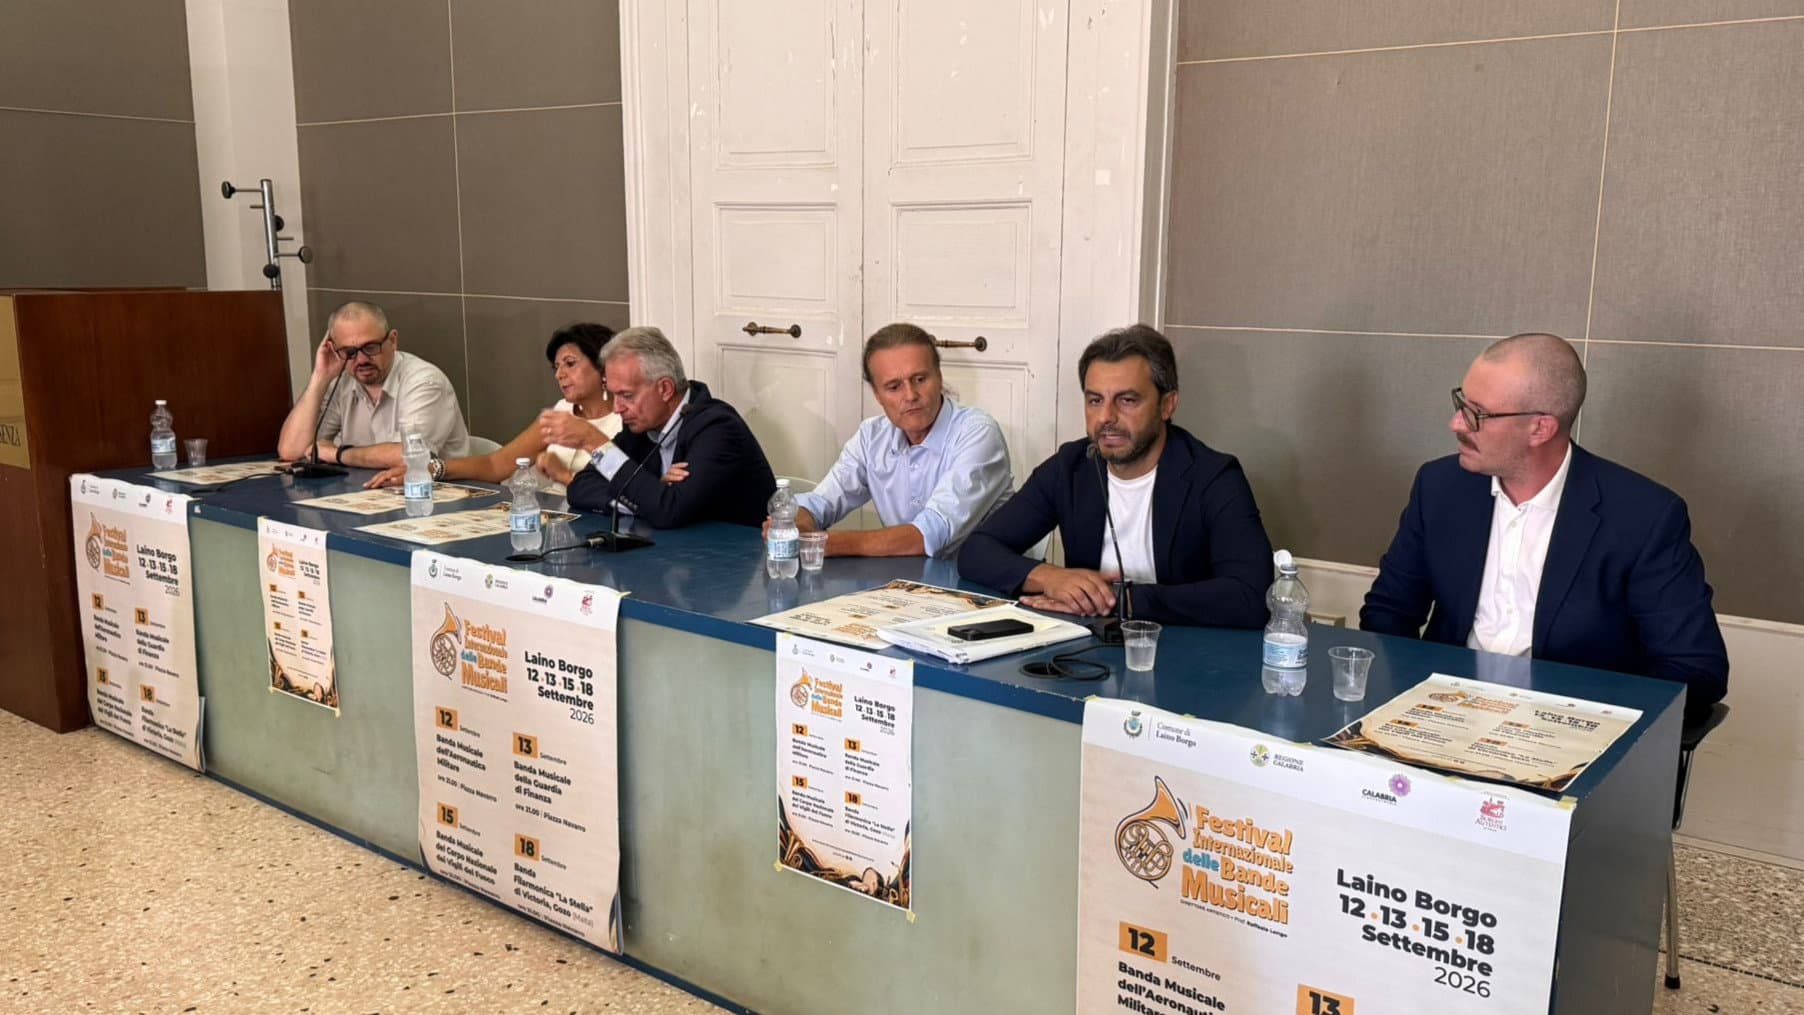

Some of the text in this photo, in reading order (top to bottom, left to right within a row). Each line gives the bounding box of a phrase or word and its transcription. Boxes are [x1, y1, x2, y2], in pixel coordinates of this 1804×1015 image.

[138, 556, 146, 568] 12
[148, 559, 156, 570] 13
[156, 548, 177, 563] Borgo
[145, 569, 179, 586] Settembre
[463, 618, 507, 647] Festival
[478, 651, 507, 674] Bande
[525, 650, 593, 680] Laino Borgo
[461, 660, 508, 694] Musicali
[527, 667, 594, 697] 12 13 15 18
[538, 685, 595, 711] Settembre
[854, 695, 896, 713] Laino Borgo
[439, 709, 453, 728] 12
[570, 707, 595, 725] 2026
[855, 703, 895, 721] 12 13 15 18
[861, 713, 895, 729] Settembre
[795, 723, 804, 736] 12
[1156, 730, 1196, 748] Laino Borgo
[1157, 720, 1191, 736] Comune di
[436, 733, 484, 758] Banda Musicale
[518, 735, 533, 755] 13
[847, 738, 857, 751] 13
[436, 745, 487, 771] dell'Aeronautica
[437, 756, 460, 773] Militare
[1272, 759, 1304, 773] CALABRIA
[1274, 753, 1304, 766] REGIONE
[513, 760, 572, 786] Banda Musicale
[514, 772, 563, 796] della Guardia
[795, 775, 804, 787] 15
[514, 785, 552, 805] di Finanza
[848, 792, 858, 805] 18
[1362, 788, 1397, 803] CALABRIA
[440, 805, 455, 825] 15
[543, 811, 562, 825] Piazza
[1195, 804, 1292, 856] Festival
[436, 829, 484, 858] Banda Musicale
[520, 836, 536, 857] 18
[1193, 830, 1293, 875] Internazionale
[447, 846, 465, 862] Corpo
[466, 855, 498, 876] Nazionale
[513, 861, 536, 879] Banda
[1182, 848, 1289, 897] delle Bande
[513, 874, 555, 899] Filarmonica
[1181, 864, 1288, 925] Musicali
[1337, 867, 1498, 929] Laino Borgo
[513, 887, 521, 897] di
[522, 889, 552, 912] Victoria,
[553, 903, 572, 918] Gozo
[1338, 893, 1496, 956] 12 13 15 18
[1128, 926, 1155, 958] 12
[1361, 924, 1493, 978] Settembre
[1171, 956, 1222, 982] Settembre
[1118, 961, 1227, 1012] Banda Musicale
[1434, 966, 1492, 999] 2026
[1309, 990, 1342, 1015] 13
